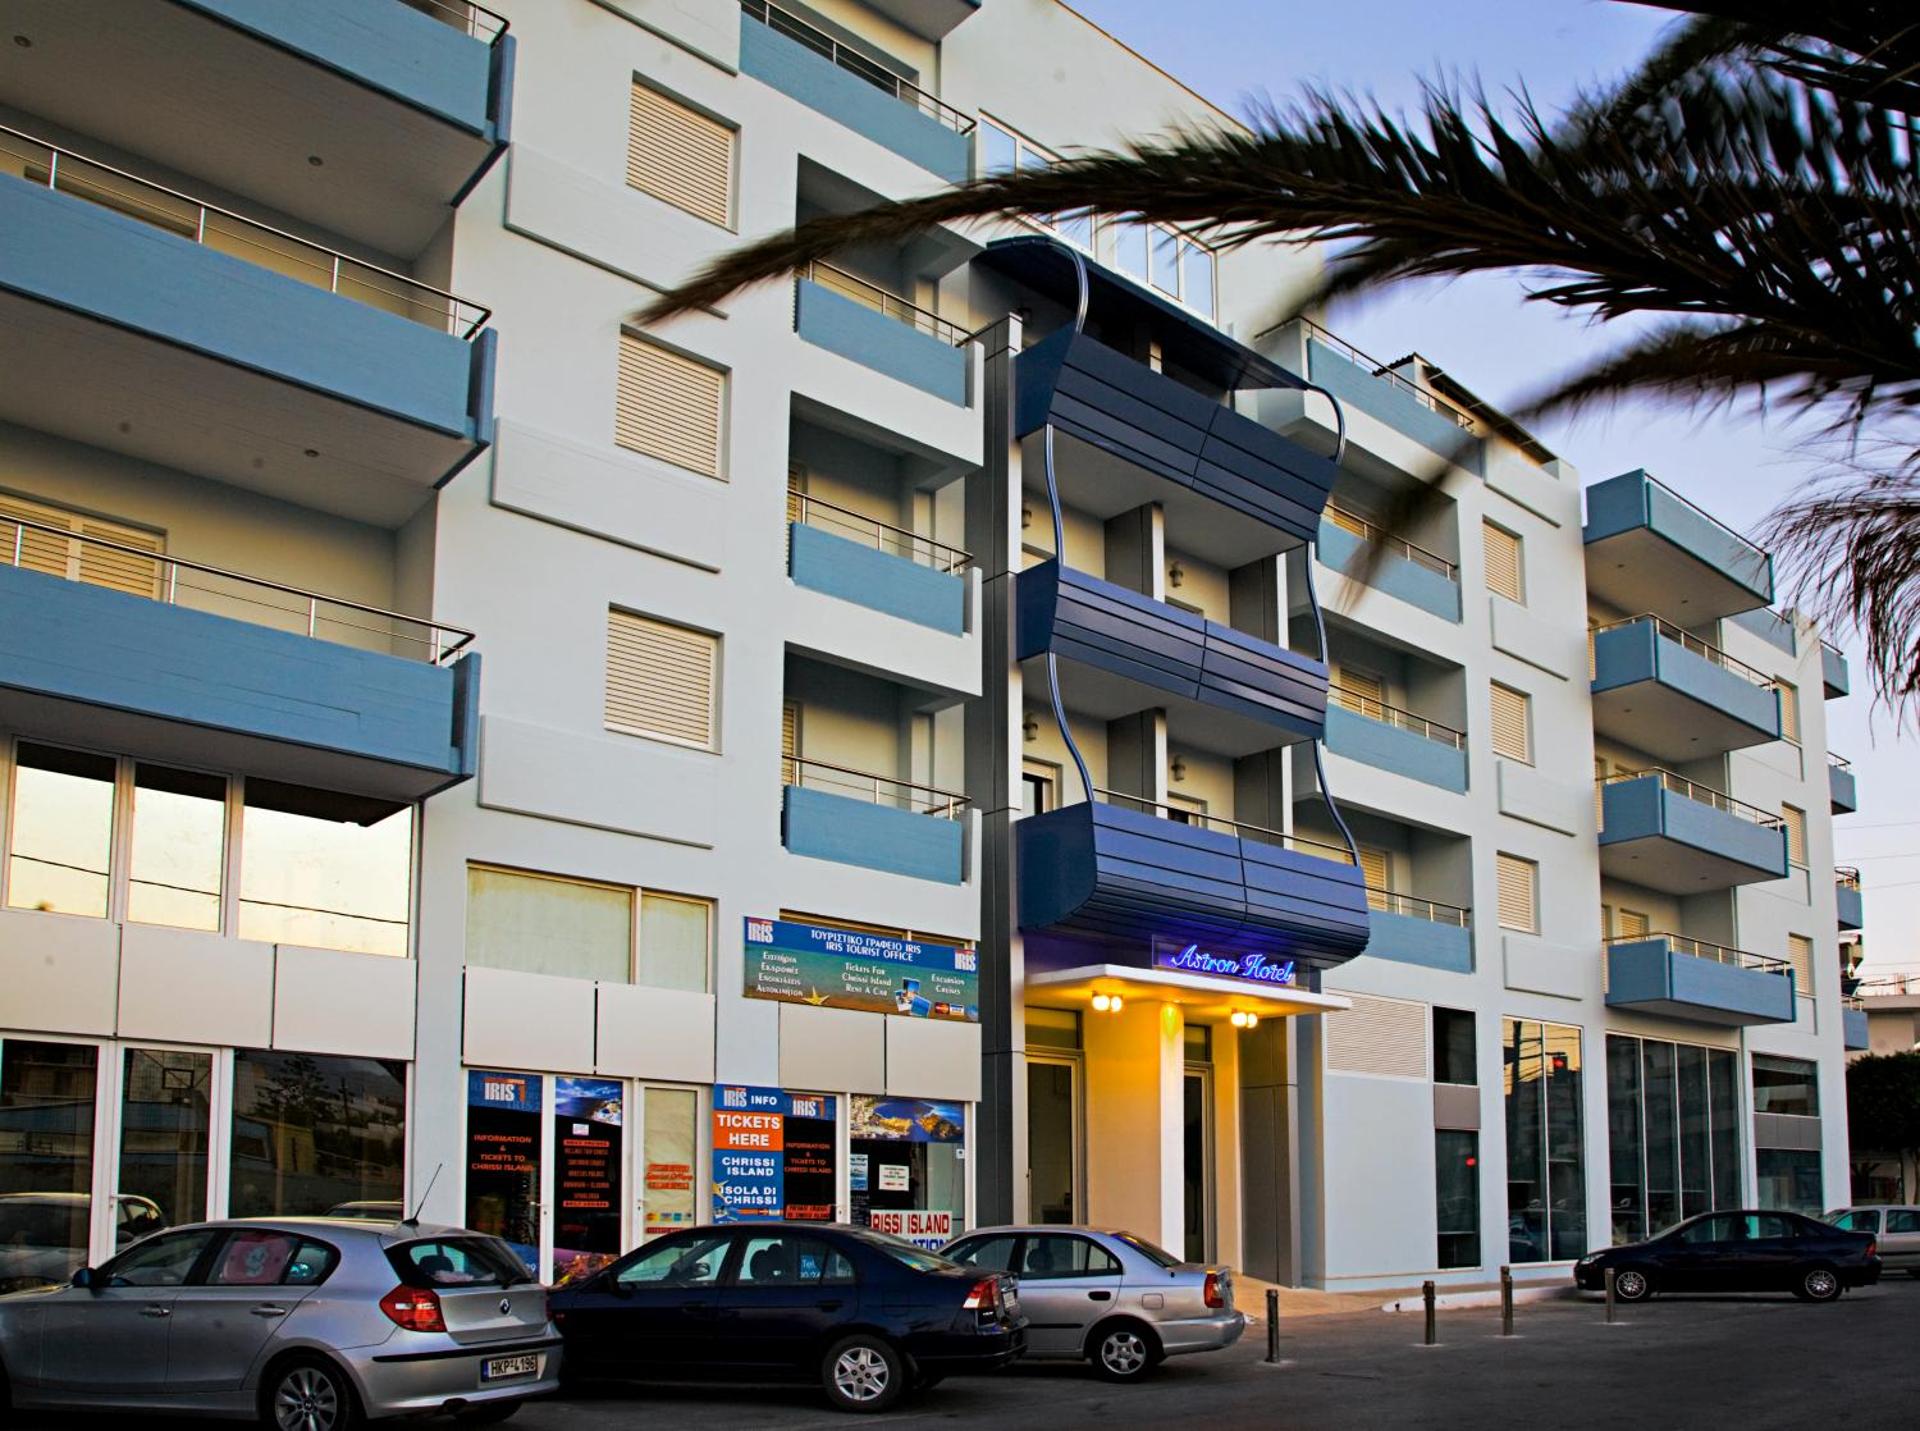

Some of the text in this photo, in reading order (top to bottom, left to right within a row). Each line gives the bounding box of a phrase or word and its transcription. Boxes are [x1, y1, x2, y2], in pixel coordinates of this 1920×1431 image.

[748, 921, 773, 943] IRIS
[826, 942, 913, 961] IRIS TOURIST OFFICE
[906, 944, 921, 954] IRIS
[955, 952, 975, 971] IRIS
[1171, 944, 1293, 981] Astron Hotel
[485, 1083, 514, 1101] IRIS
[724, 1090, 777, 1107] IRIS INFO
[793, 1101, 816, 1116] IRIS
[717, 1114, 780, 1129] TICKETS
[474, 1135, 532, 1143] INFORMATION
[729, 1133, 769, 1146] HERE
[722, 1157, 774, 1166] CHRISSI
[727, 1167, 773, 1176] ISLAND
[721, 1186, 759, 1194] ISOLA
[725, 1196, 776, 1204] CHRISSI
[908, 1214, 949, 1234] ISLAND
